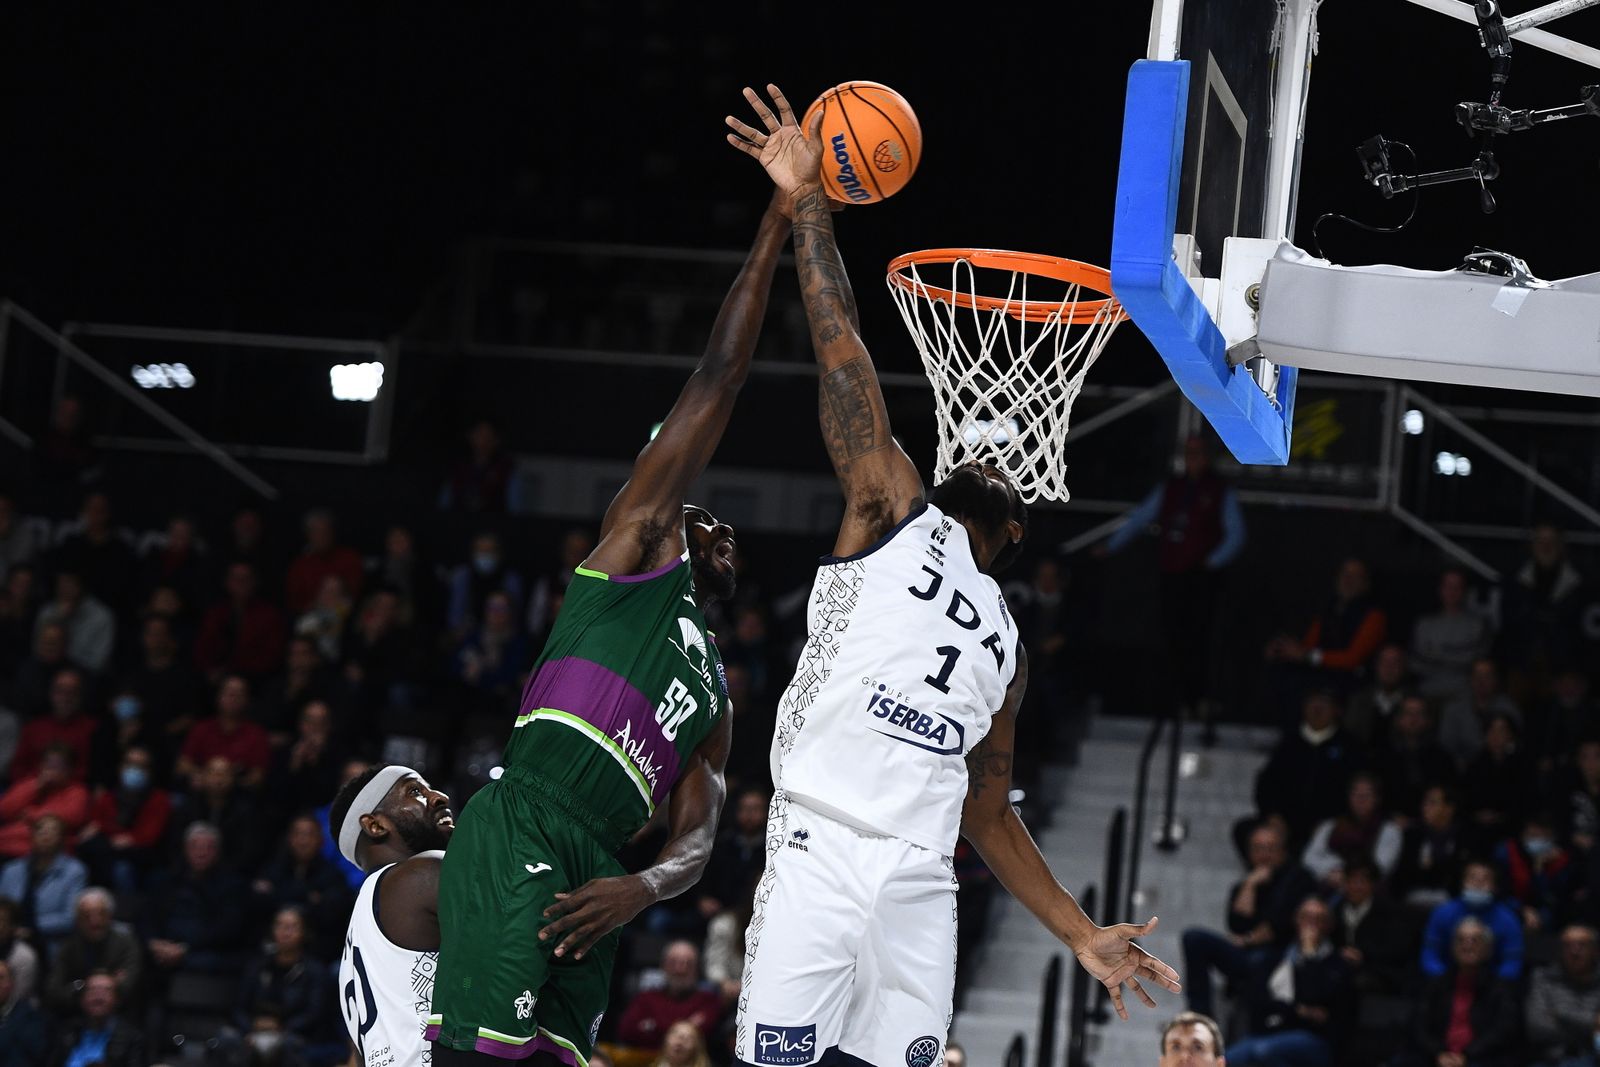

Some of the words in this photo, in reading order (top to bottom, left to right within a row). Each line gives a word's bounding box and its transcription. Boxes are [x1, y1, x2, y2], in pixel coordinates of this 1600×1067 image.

[831, 133, 872, 202] Wilson
[924, 645, 962, 695] 1
[654, 676, 698, 742] 50
[787, 840, 809, 853] errea
[758, 1030, 814, 1056] Plus
[761, 1055, 810, 1063] COLLECTION
